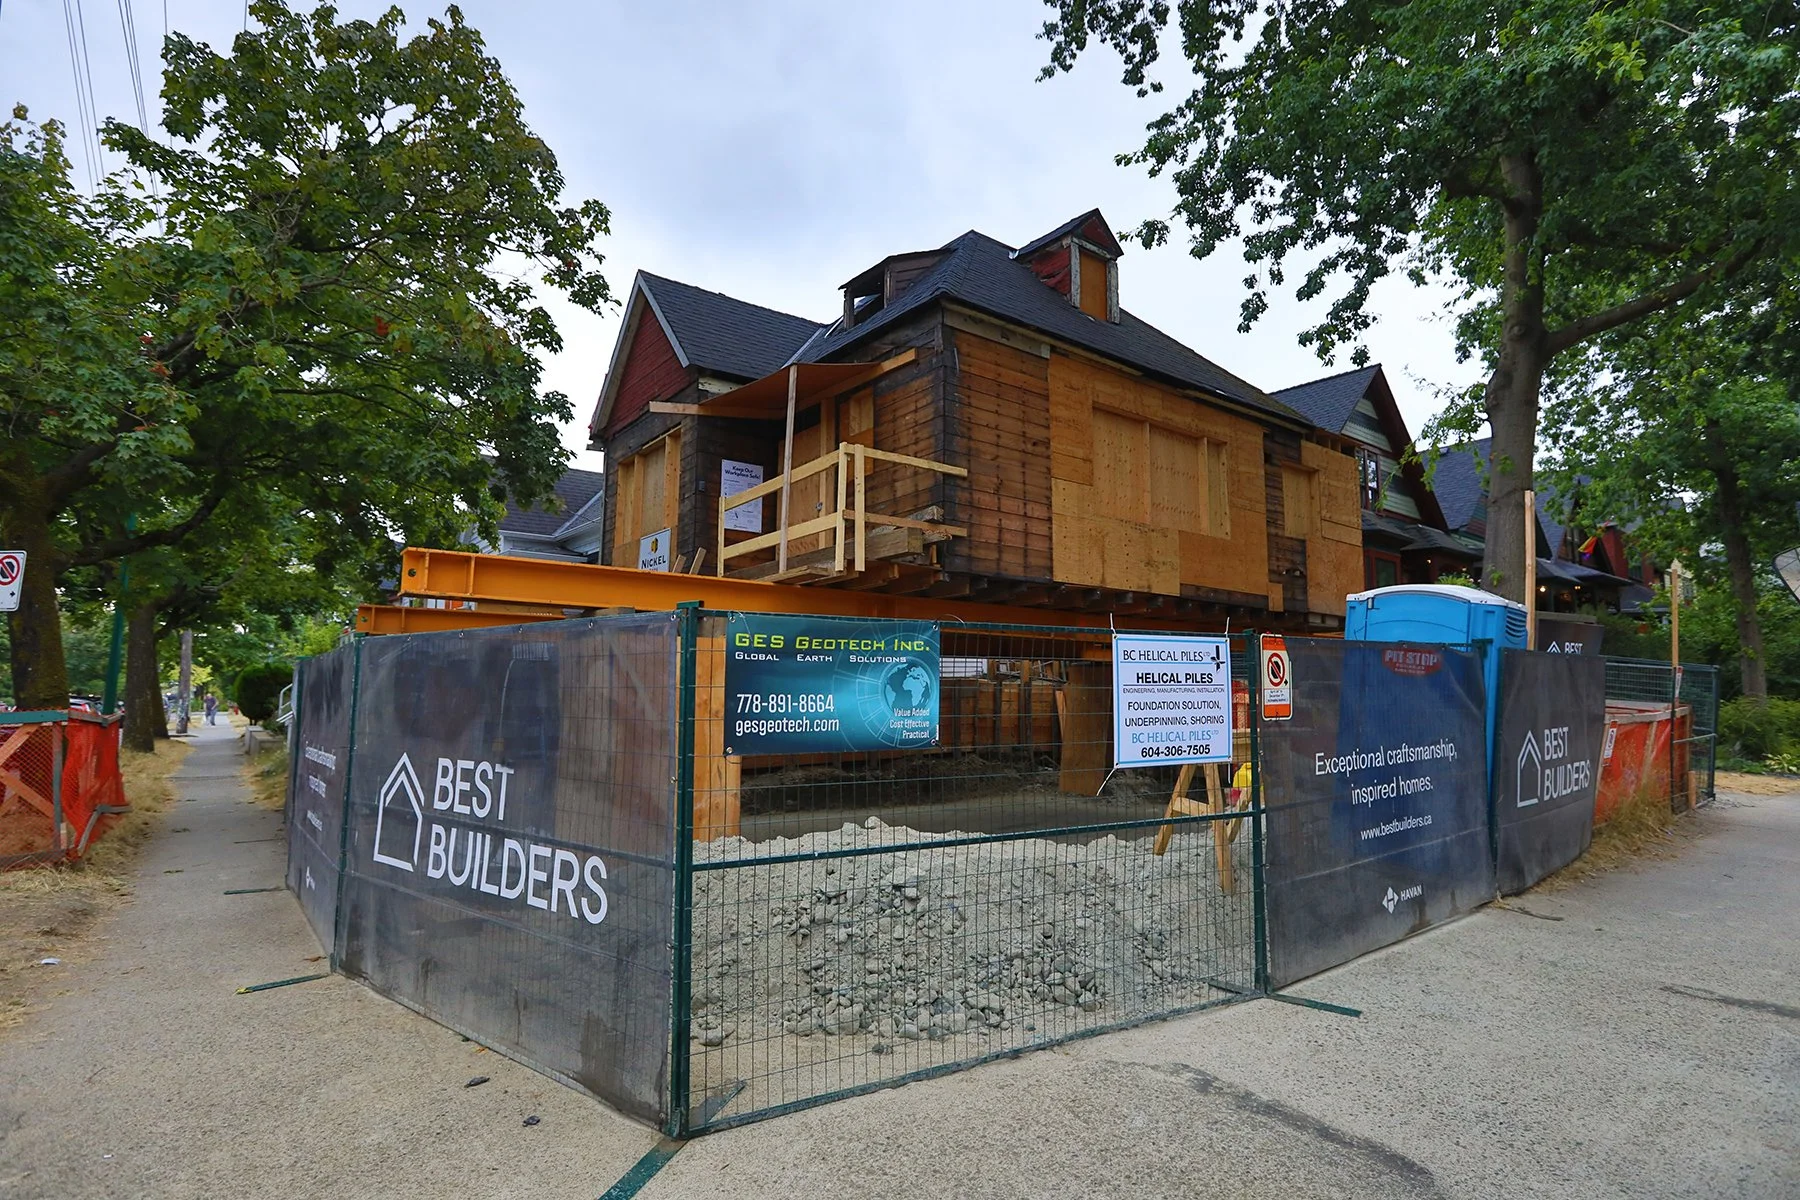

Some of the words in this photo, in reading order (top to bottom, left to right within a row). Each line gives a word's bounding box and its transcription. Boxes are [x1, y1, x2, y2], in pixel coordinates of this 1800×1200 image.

[641, 555, 667, 569] NICKEL
[735, 633, 785, 649] GES
[795, 636, 885, 651] GEOTECH
[735, 651, 780, 661] GLOBAL
[796, 653, 833, 662] EARTH
[849, 654, 907, 664] SOLUTIONS
[1123, 649, 1136, 661] BC
[1138, 650, 1179, 662] HELICAL
[1181, 651, 1204, 662] PILES
[1385, 650, 1404, 663] PIT
[1136, 672, 1182, 684] HELICAL
[1185, 673, 1213, 684] PILES
[736, 693, 835, 714] 778-891-8664
[1127, 701, 1181, 711] FOUNDATION
[1181, 700, 1222, 710] SOLUTION,
[893, 708, 911, 717] Value
[911, 708, 930, 717] Added
[735, 715, 840, 737] gesgeotech.com
[889, 719, 904, 729] Cost
[904, 719, 930, 729] Effective
[1124, 716, 1189, 727] UNDERPINNING,
[1190, 715, 1225, 725] SHORING
[902, 730, 930, 739] Practical
[1131, 732, 1145, 744] BC
[1147, 731, 1187, 743] HELICAL
[1189, 730, 1212, 741] PILES
[1544, 726, 1569, 761] BEST
[1141, 744, 1211, 758] 604-306-7505
[1315, 746, 1385, 777] Exceptional
[1386, 738, 1458, 764] craftsmanship,
[1544, 759, 1591, 802] BUILDERS
[433, 757, 515, 821] BEST
[1351, 776, 1397, 808] inspired
[1399, 775, 1434, 796] homes.
[1360, 814, 1433, 841] www.bestbuilders.ca
[427, 823, 608, 925] BUILDERS
[1400, 884, 1423, 902] HAVAN
